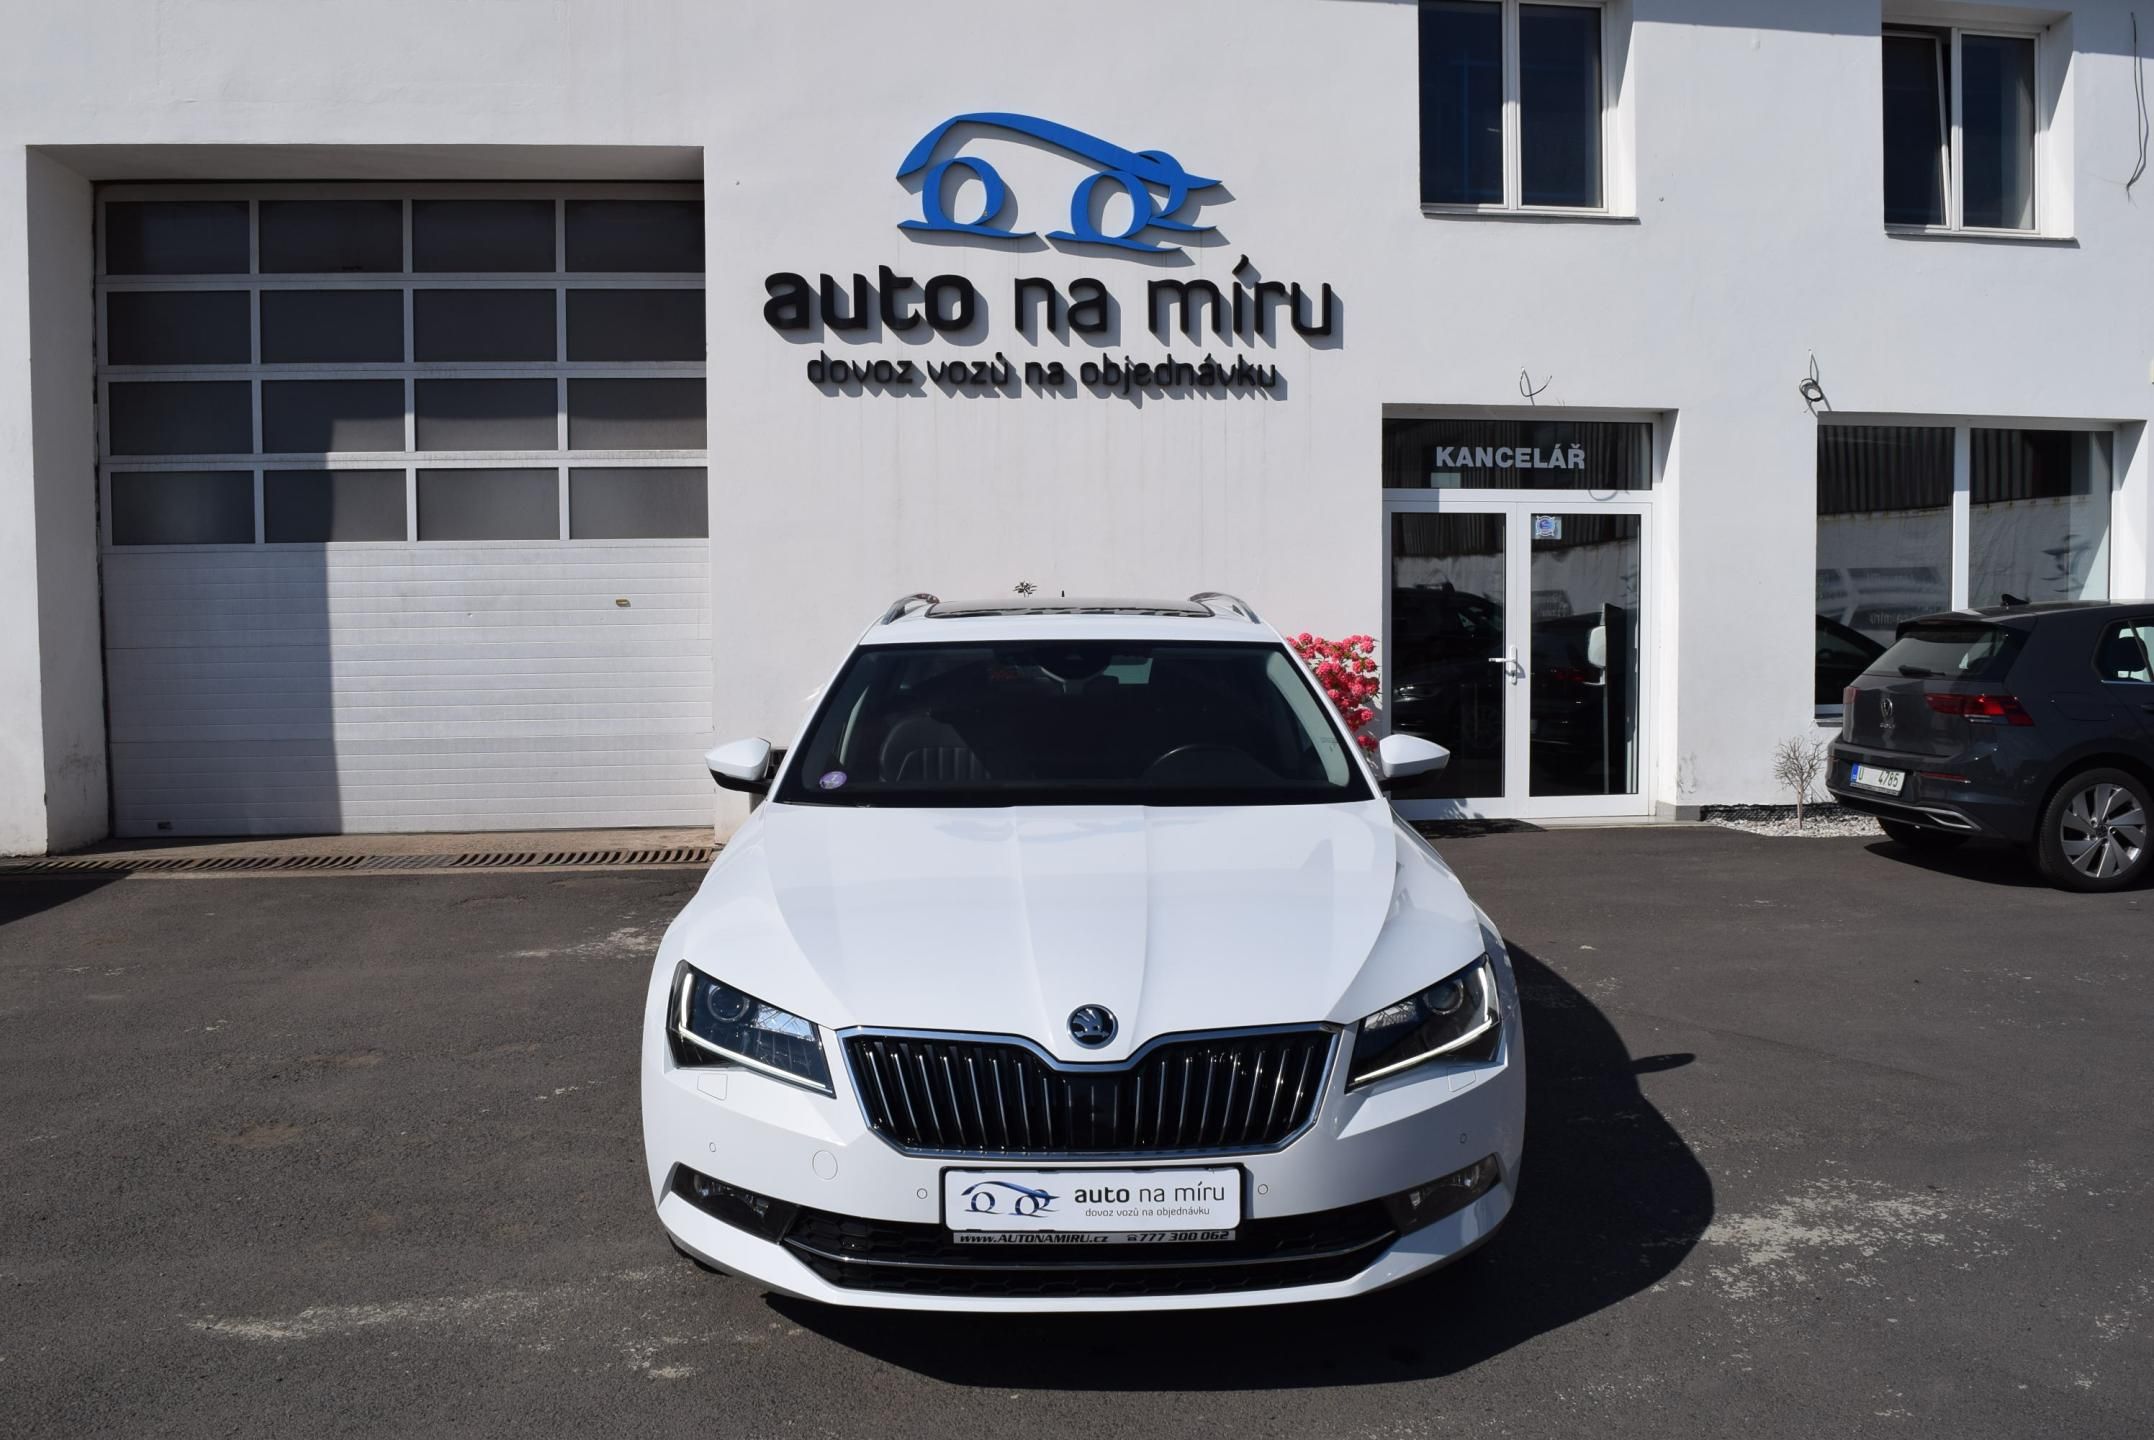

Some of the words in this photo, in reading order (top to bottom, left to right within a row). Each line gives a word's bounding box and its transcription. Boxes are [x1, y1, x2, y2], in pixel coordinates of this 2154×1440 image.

[763, 265, 976, 333] auto
[1014, 277, 1109, 334] na
[1146, 254, 1333, 336] míru
[806, 350, 914, 385] dovoz
[926, 351, 1010, 386] vozů
[1024, 360, 1065, 386] na
[1079, 352, 1277, 396] objednávku
[1435, 443, 1586, 470] KANCELÁŘ
[1074, 1186, 1131, 1204] auto
[1139, 1187, 1166, 1203] na
[1174, 1181, 1225, 1202] míru
[1085, 1208, 1114, 1217] dovoz
[1116, 1207, 1139, 1217] vozů
[1141, 1209, 1154, 1217] na
[1156, 1205, 1210, 1219] objednávku
[959, 1232, 1109, 1244] www.AUTONAMIRU.cz
[1139, 1232, 1166, 1242] 777
[1168, 1231, 1199, 1241] 300
[1200, 1230, 1230, 1240] 062
